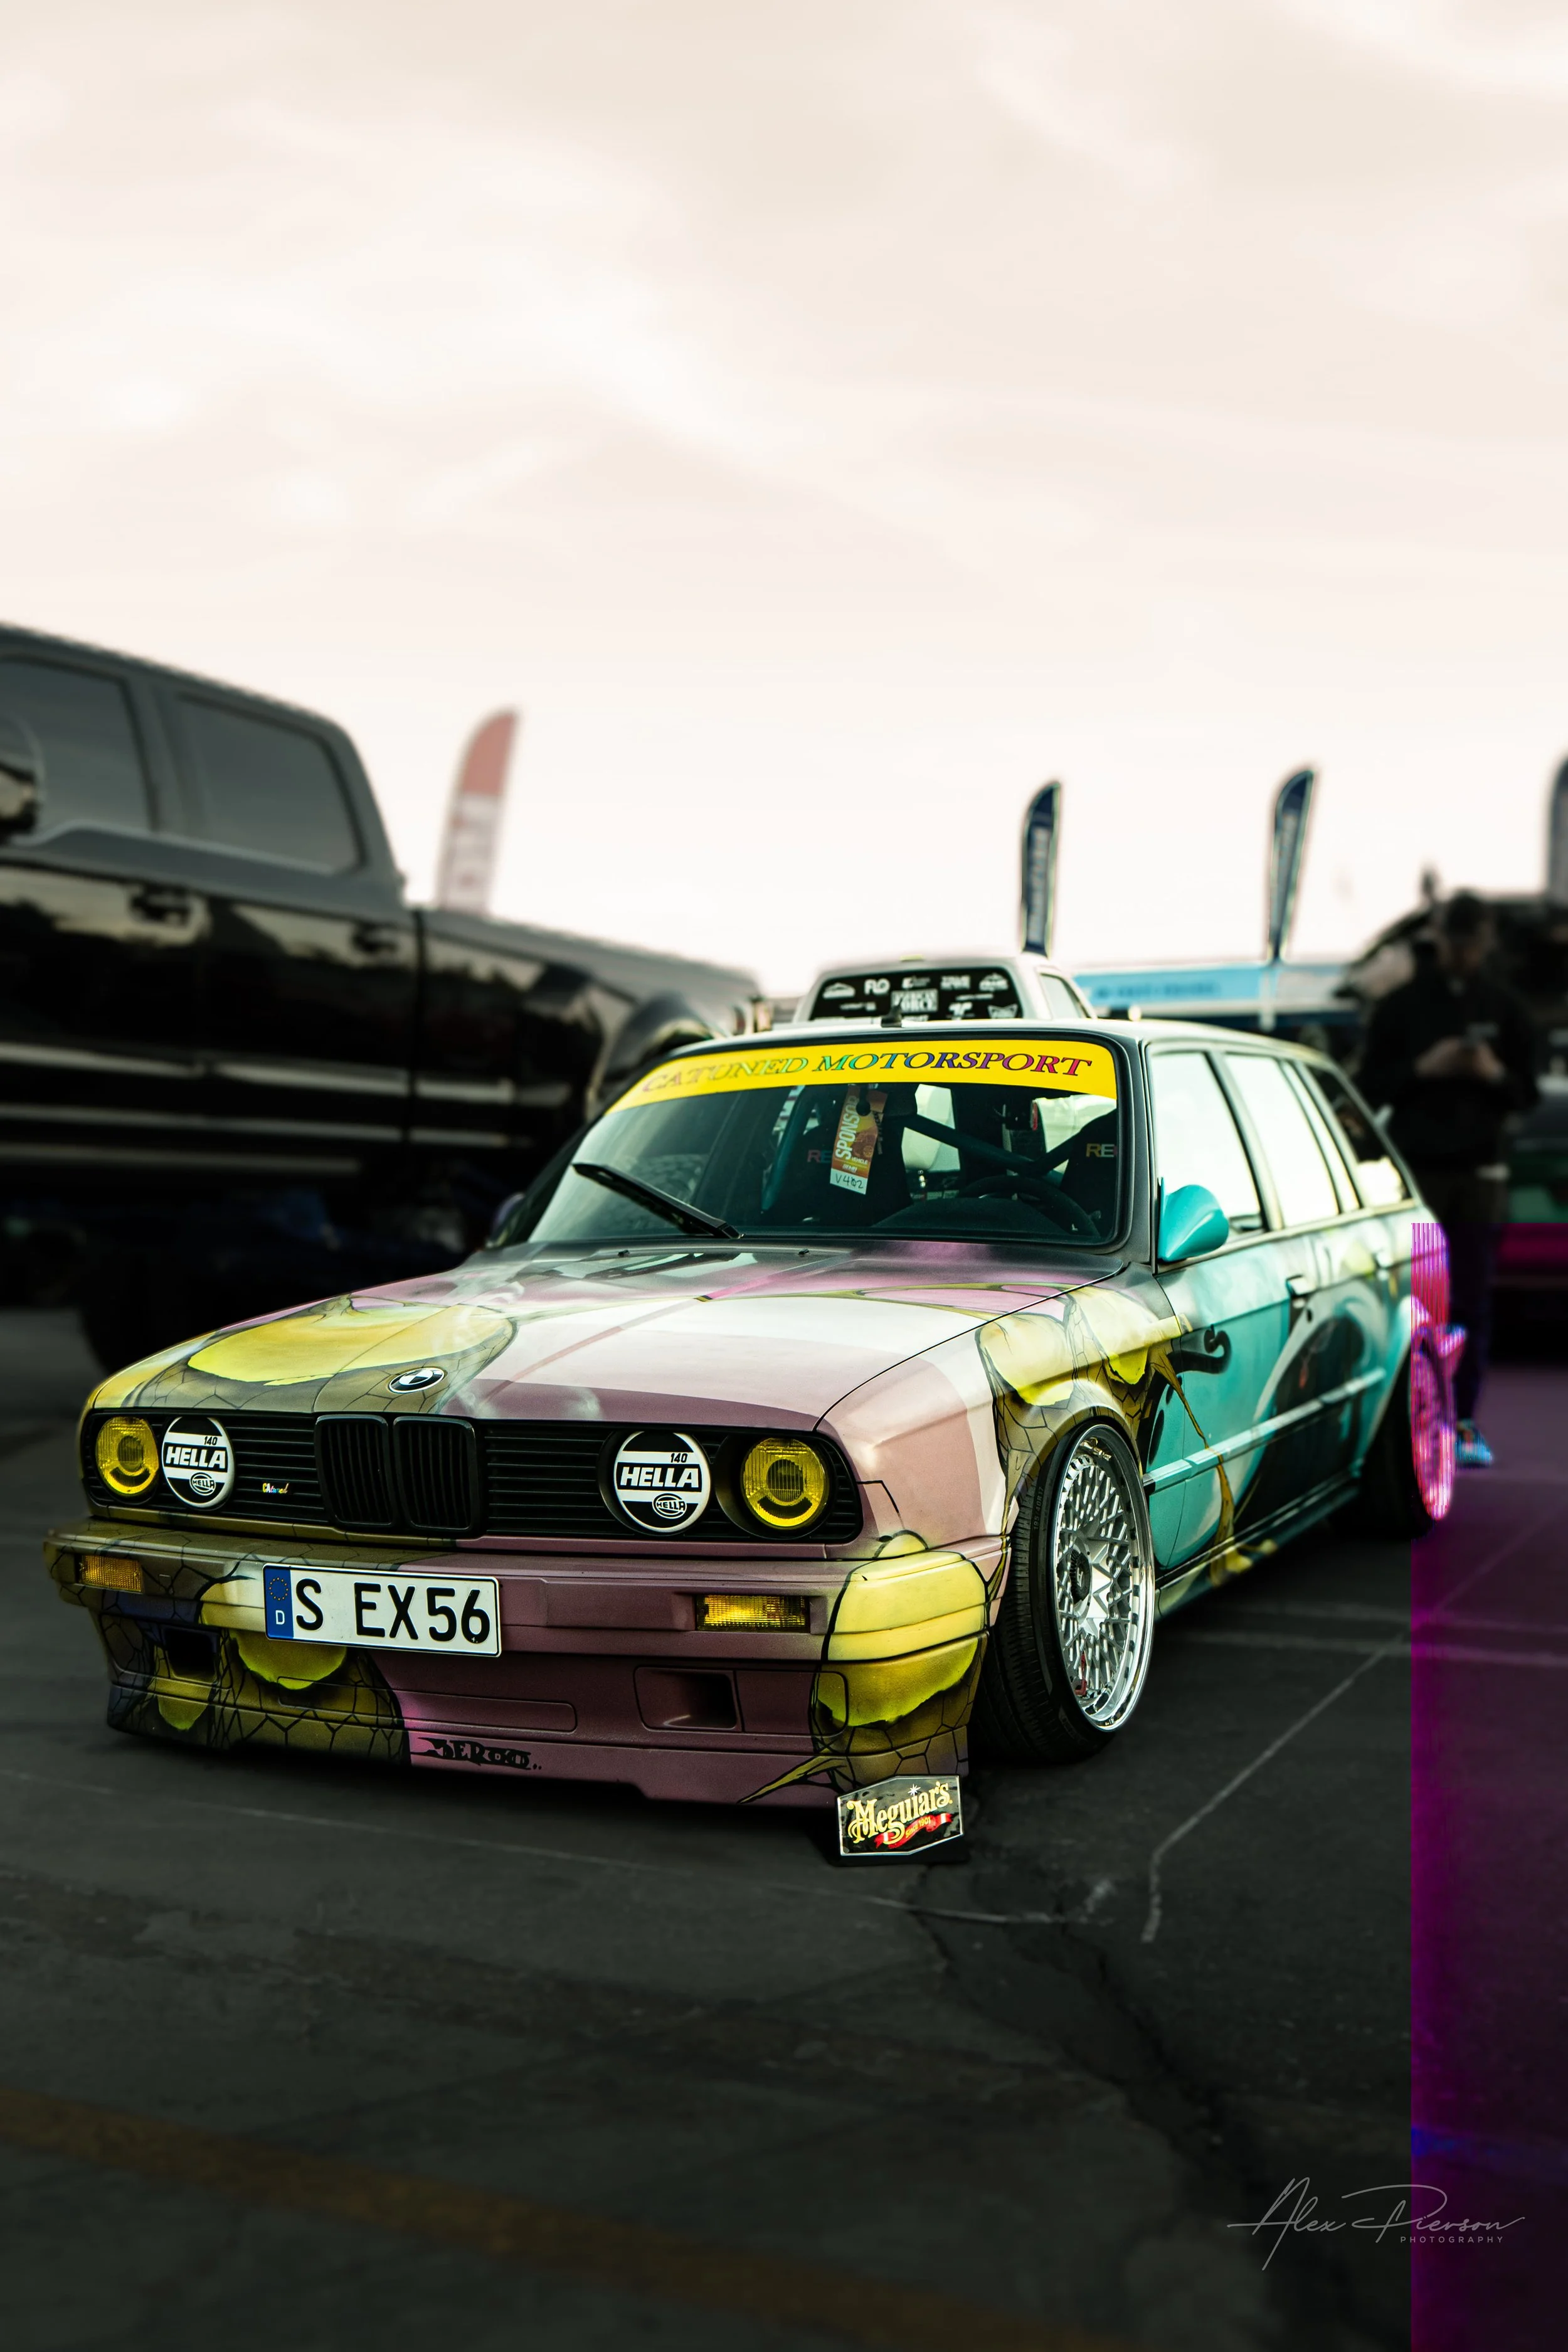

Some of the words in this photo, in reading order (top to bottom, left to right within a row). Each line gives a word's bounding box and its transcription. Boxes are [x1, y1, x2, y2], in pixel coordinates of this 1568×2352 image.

[642, 1057, 808, 1092] CATUNED
[812, 1051, 1092, 1076] MOTORSPORT
[204, 1436, 218, 1446] 140
[166, 1446, 226, 1469] HELLA
[670, 1453, 688, 1463] 140
[192, 1478, 216, 1489] HELLA
[620, 1466, 699, 1488] HELLA
[656, 1500, 686, 1512] HELLA
[295, 1578, 324, 1631] S
[275, 1609, 285, 1626] D
[847, 1781, 951, 1844] Meguiar's
[905, 1825, 918, 1838] Since
[918, 1817, 931, 1829] 1901
